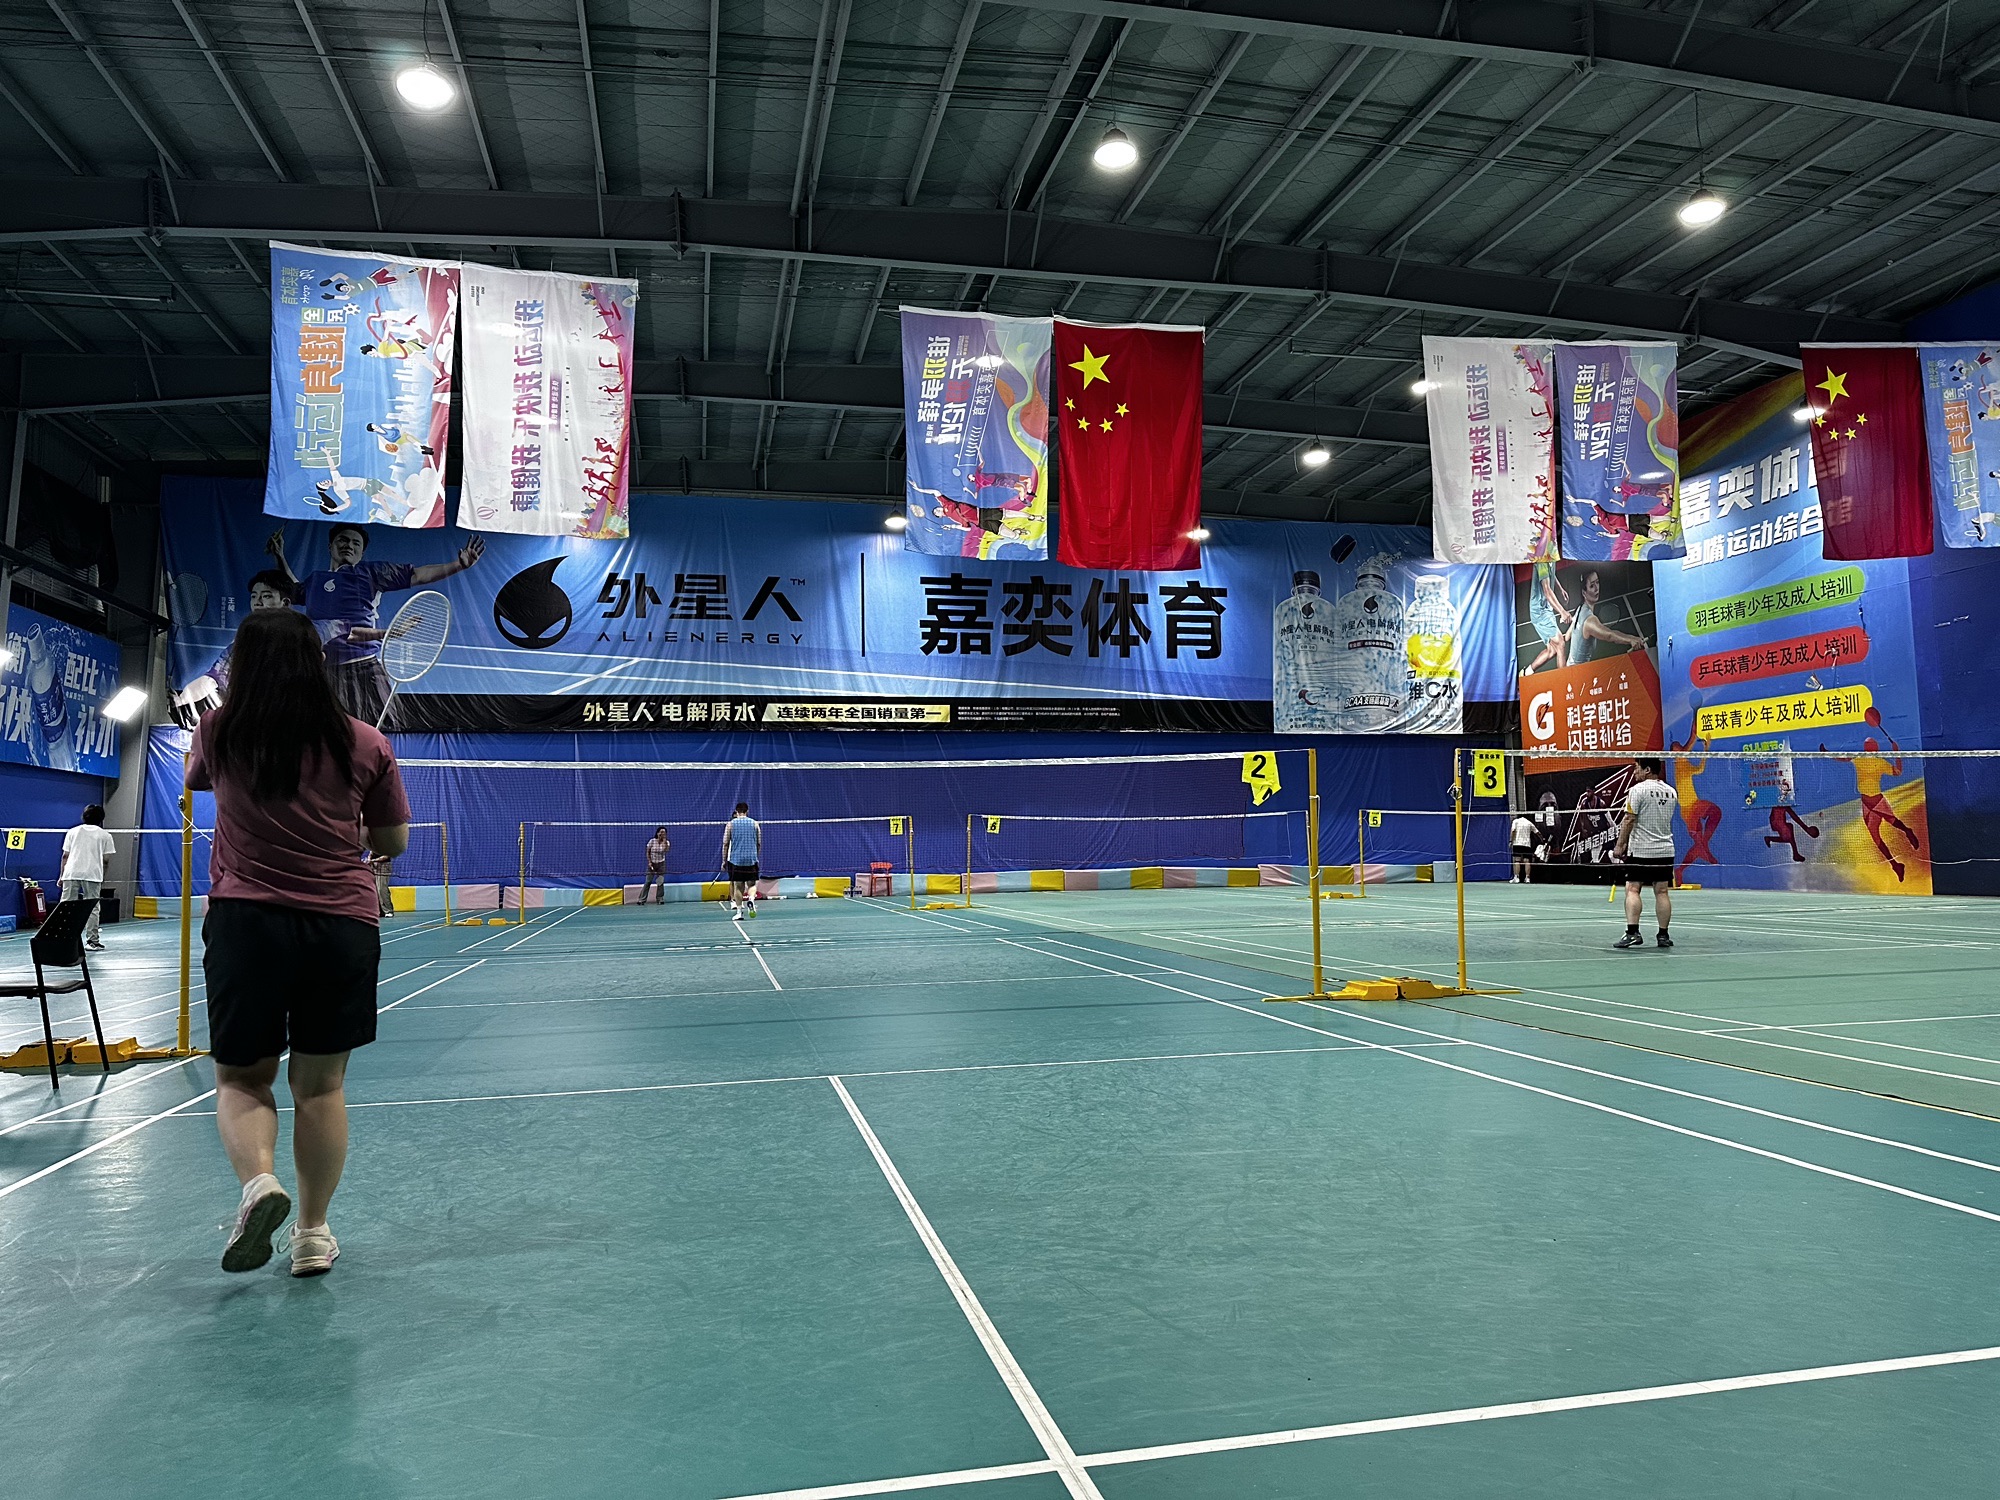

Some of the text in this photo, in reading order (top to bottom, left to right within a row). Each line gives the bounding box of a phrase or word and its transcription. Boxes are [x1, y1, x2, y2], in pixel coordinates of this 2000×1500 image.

[597, 573, 803, 622] 外星人
[1694, 575, 1853, 628] 羽毛球青少年及成人培训
[919, 573, 1229, 660] 嘉奕体育
[597, 631, 803, 645] ALIENERGY
[1698, 633, 1858, 681] 乒乓球青少年及成人培训
[63, 652, 99, 696] 配比
[1408, 681, 1458, 700] 维C水
[582, 702, 756, 722] 外星人 电解质水
[777, 706, 942, 720] 连续两年全国销量第一
[1528, 690, 1555, 741] G
[1566, 697, 1631, 728] 科学配比
[1701, 693, 1861, 732] 篮球青少年及成人培训
[1568, 722, 1632, 752] 闪电补给
[1250, 754, 1267, 778] 2
[1484, 766, 1497, 789] 3
[893, 824, 899, 833] 7
[990, 822, 996, 831] 6
[1372, 816, 1378, 825] 5
[12, 835, 20, 846] 8
